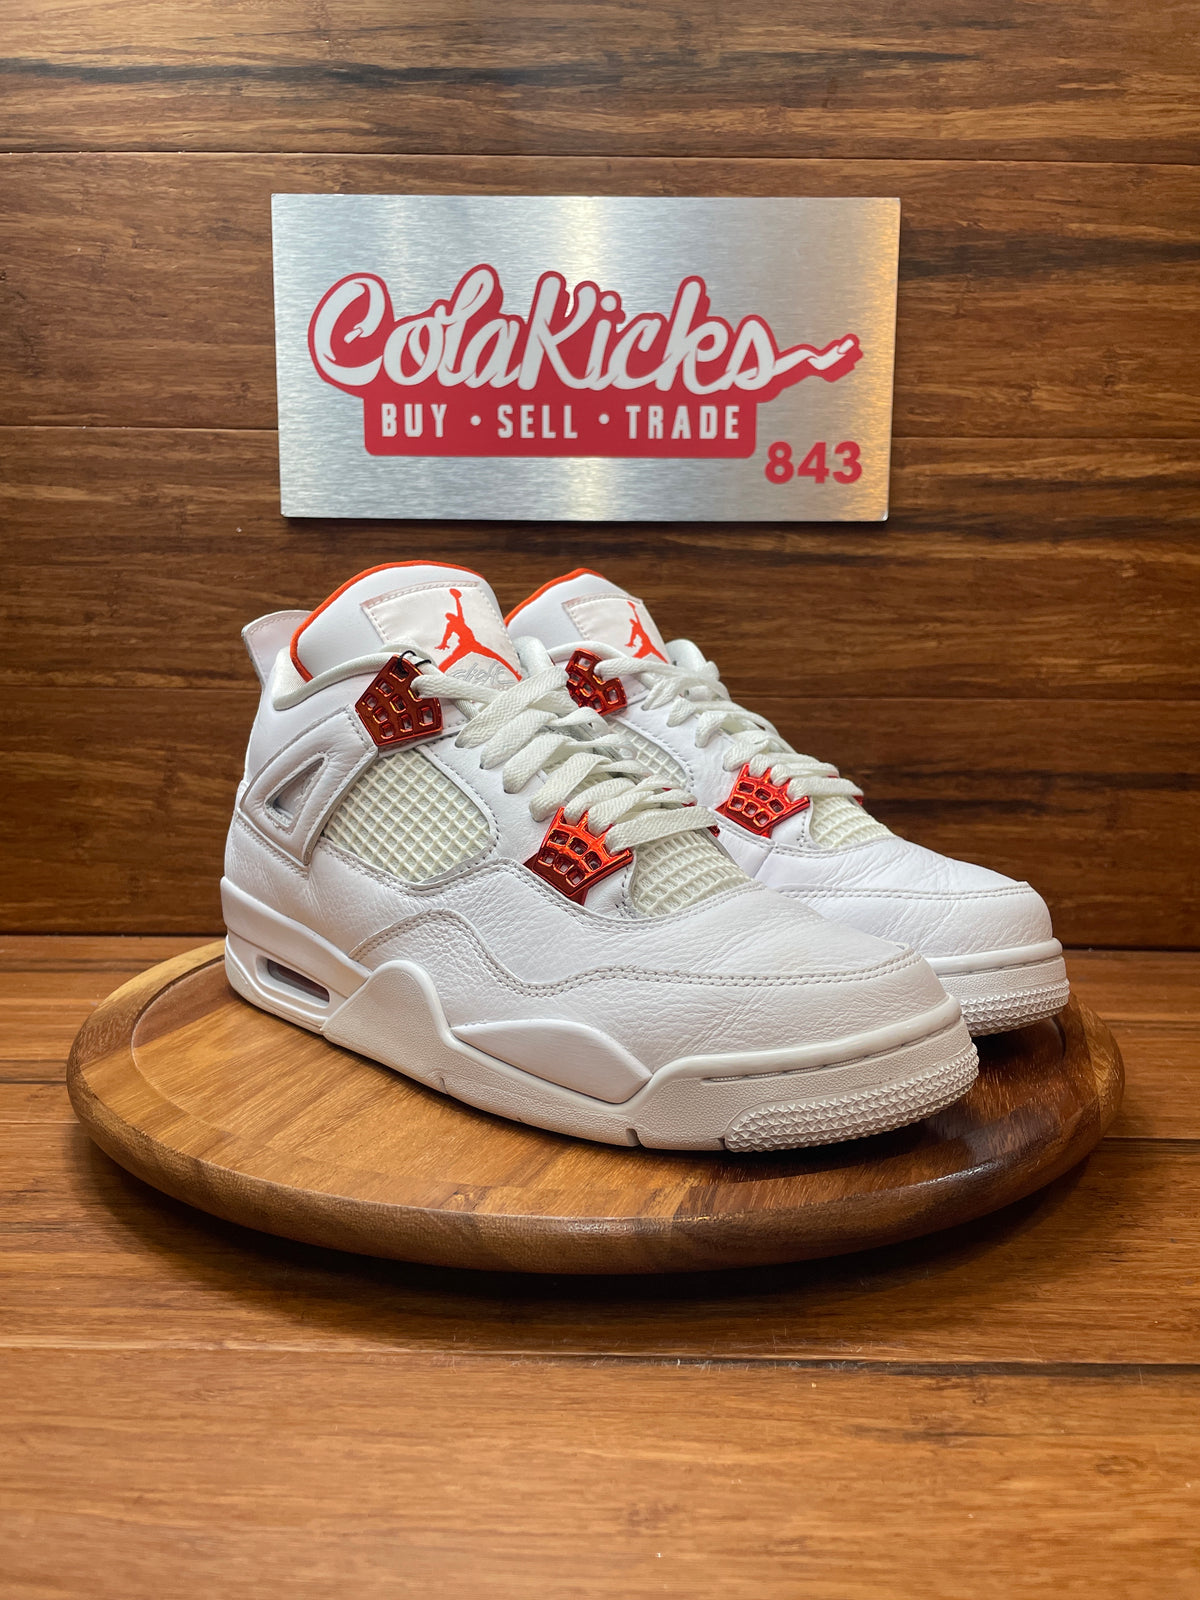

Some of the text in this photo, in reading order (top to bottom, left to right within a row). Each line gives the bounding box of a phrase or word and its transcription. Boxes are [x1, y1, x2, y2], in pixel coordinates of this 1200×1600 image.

[313, 270, 855, 394] ColaKicks
[382, 403, 739, 439] BUY SELL TRADE
[765, 441, 862, 484] 843
